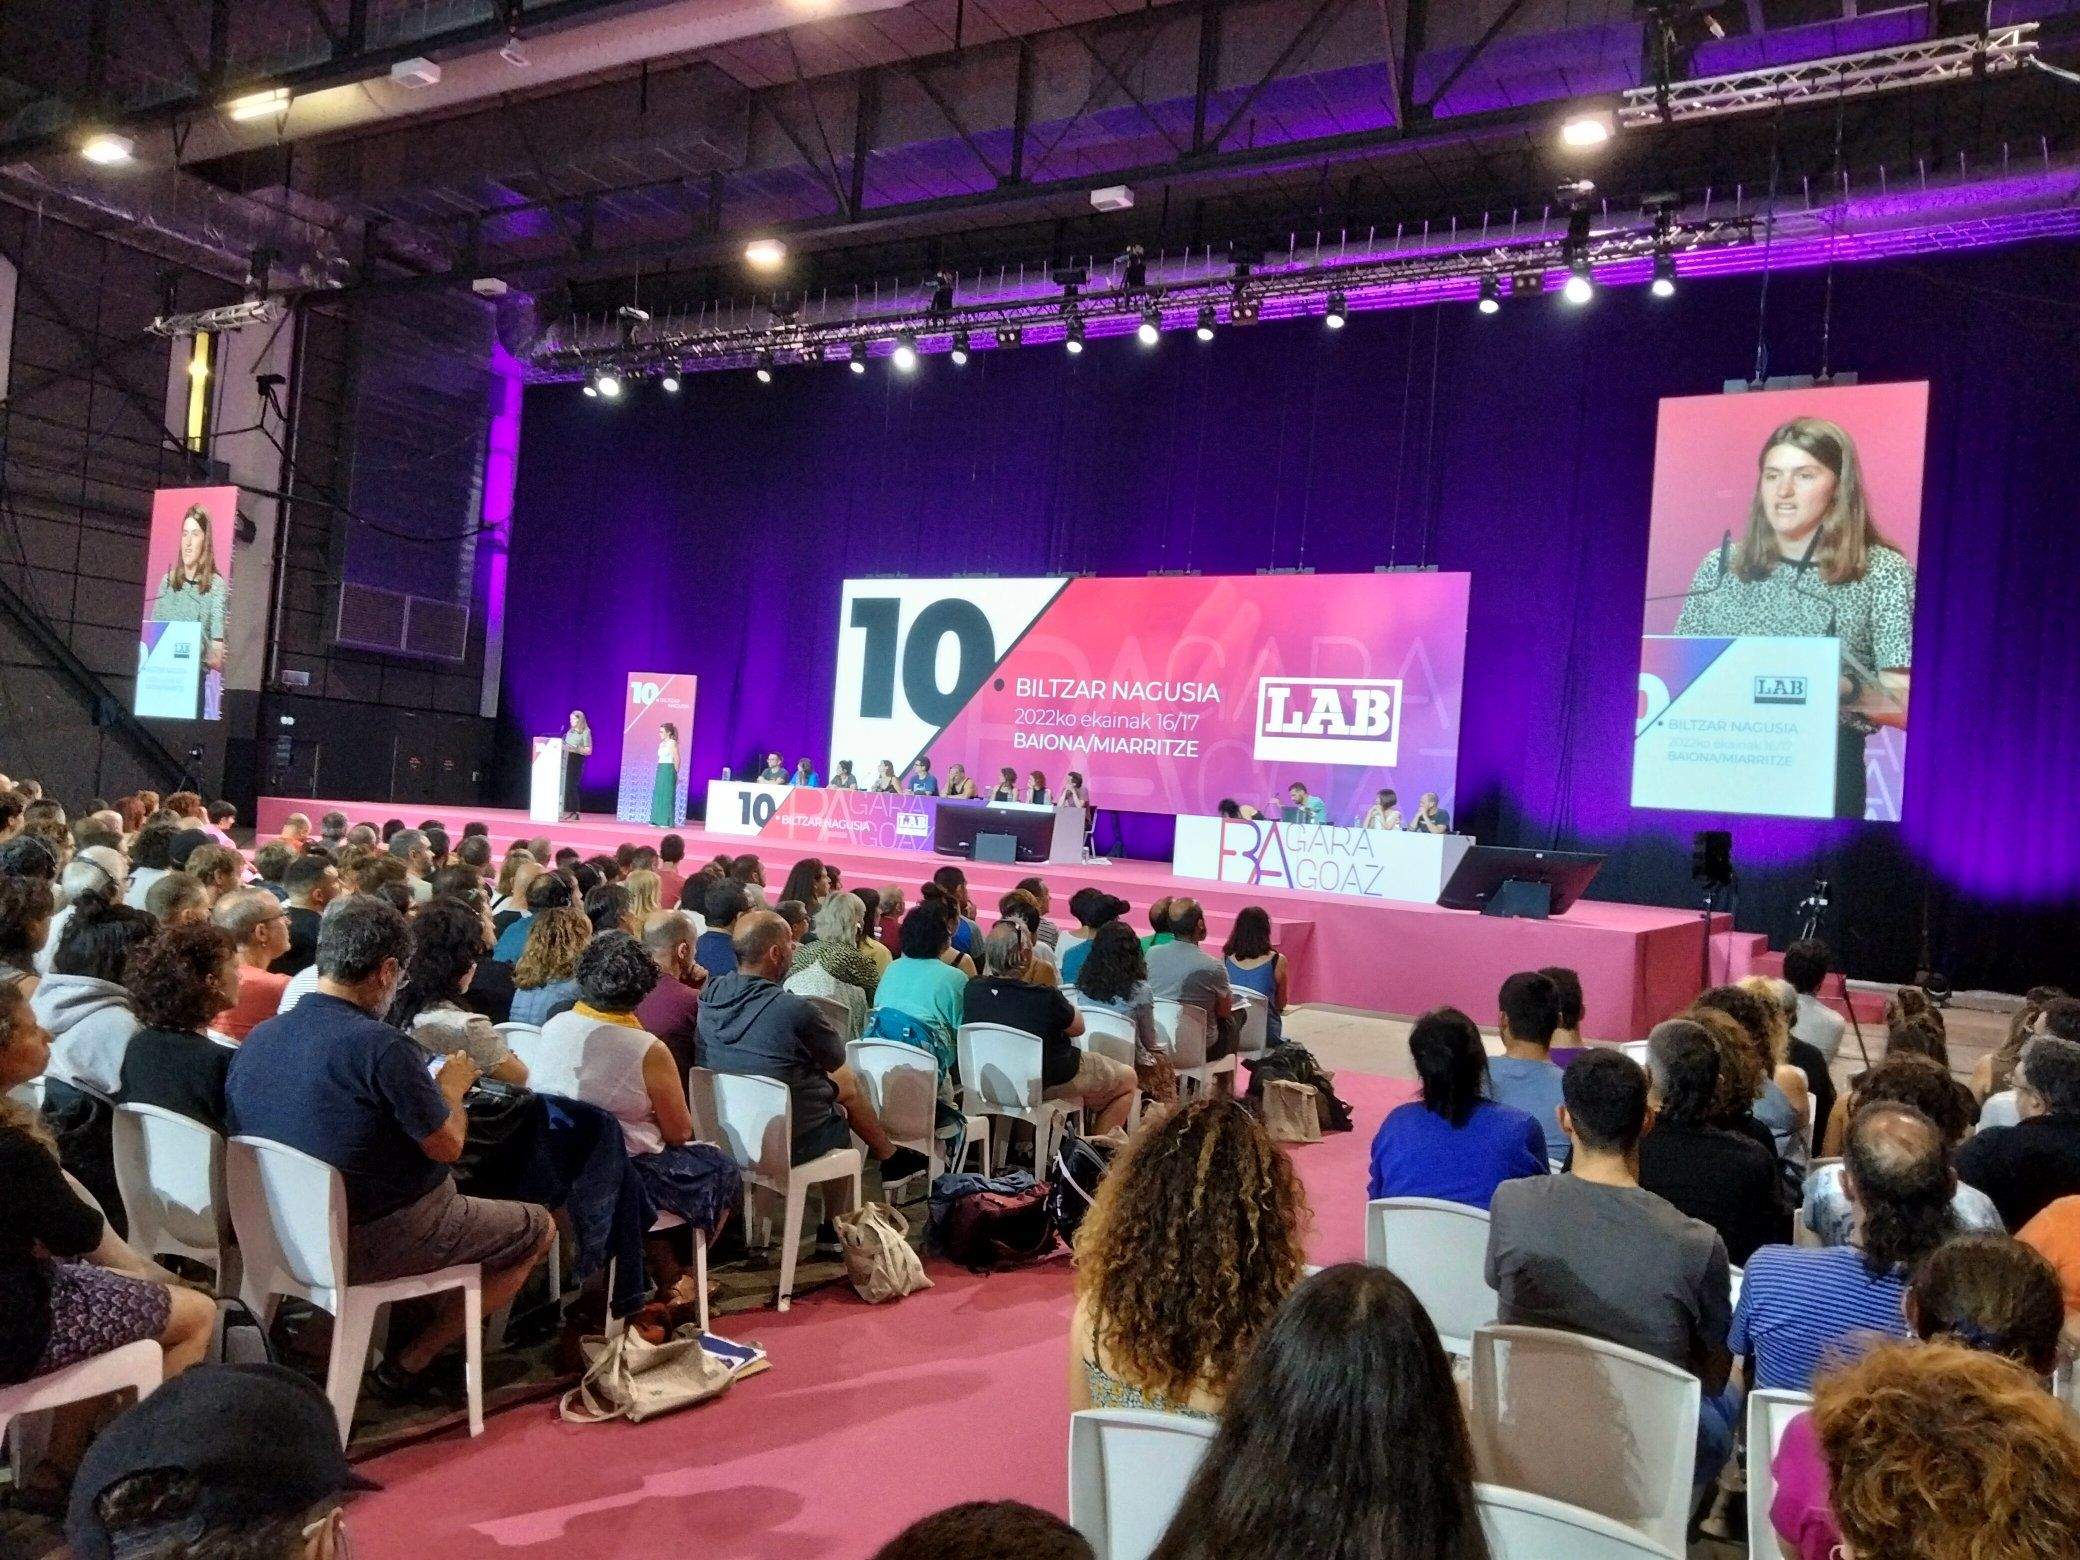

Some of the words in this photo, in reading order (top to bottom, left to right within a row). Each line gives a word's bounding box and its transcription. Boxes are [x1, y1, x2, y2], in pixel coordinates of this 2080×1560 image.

[1016, 678, 1106, 699] BILTZAR
[1112, 681, 1221, 703] NAGUSIA
[1757, 679, 1804, 695] LAB
[1014, 708, 1077, 727] 2022ko
[1080, 711, 1151, 730] ekainak
[1156, 713, 1200, 733] 16/17
[1265, 687, 1391, 736] LAB
[1668, 718, 1727, 732] BILTZAR
[1730, 721, 1799, 735] NAGUSIA
[1013, 732, 1199, 758] BAIONA/MIARRITZE
[1667, 750, 1793, 767] BAIONA/MIARRITZE
[781, 814, 822, 828] BILTZAR
[824, 817, 871, 832] NAGUSIA
[1286, 822, 1374, 858] GARA
[1296, 859, 1384, 896] GOAZ
